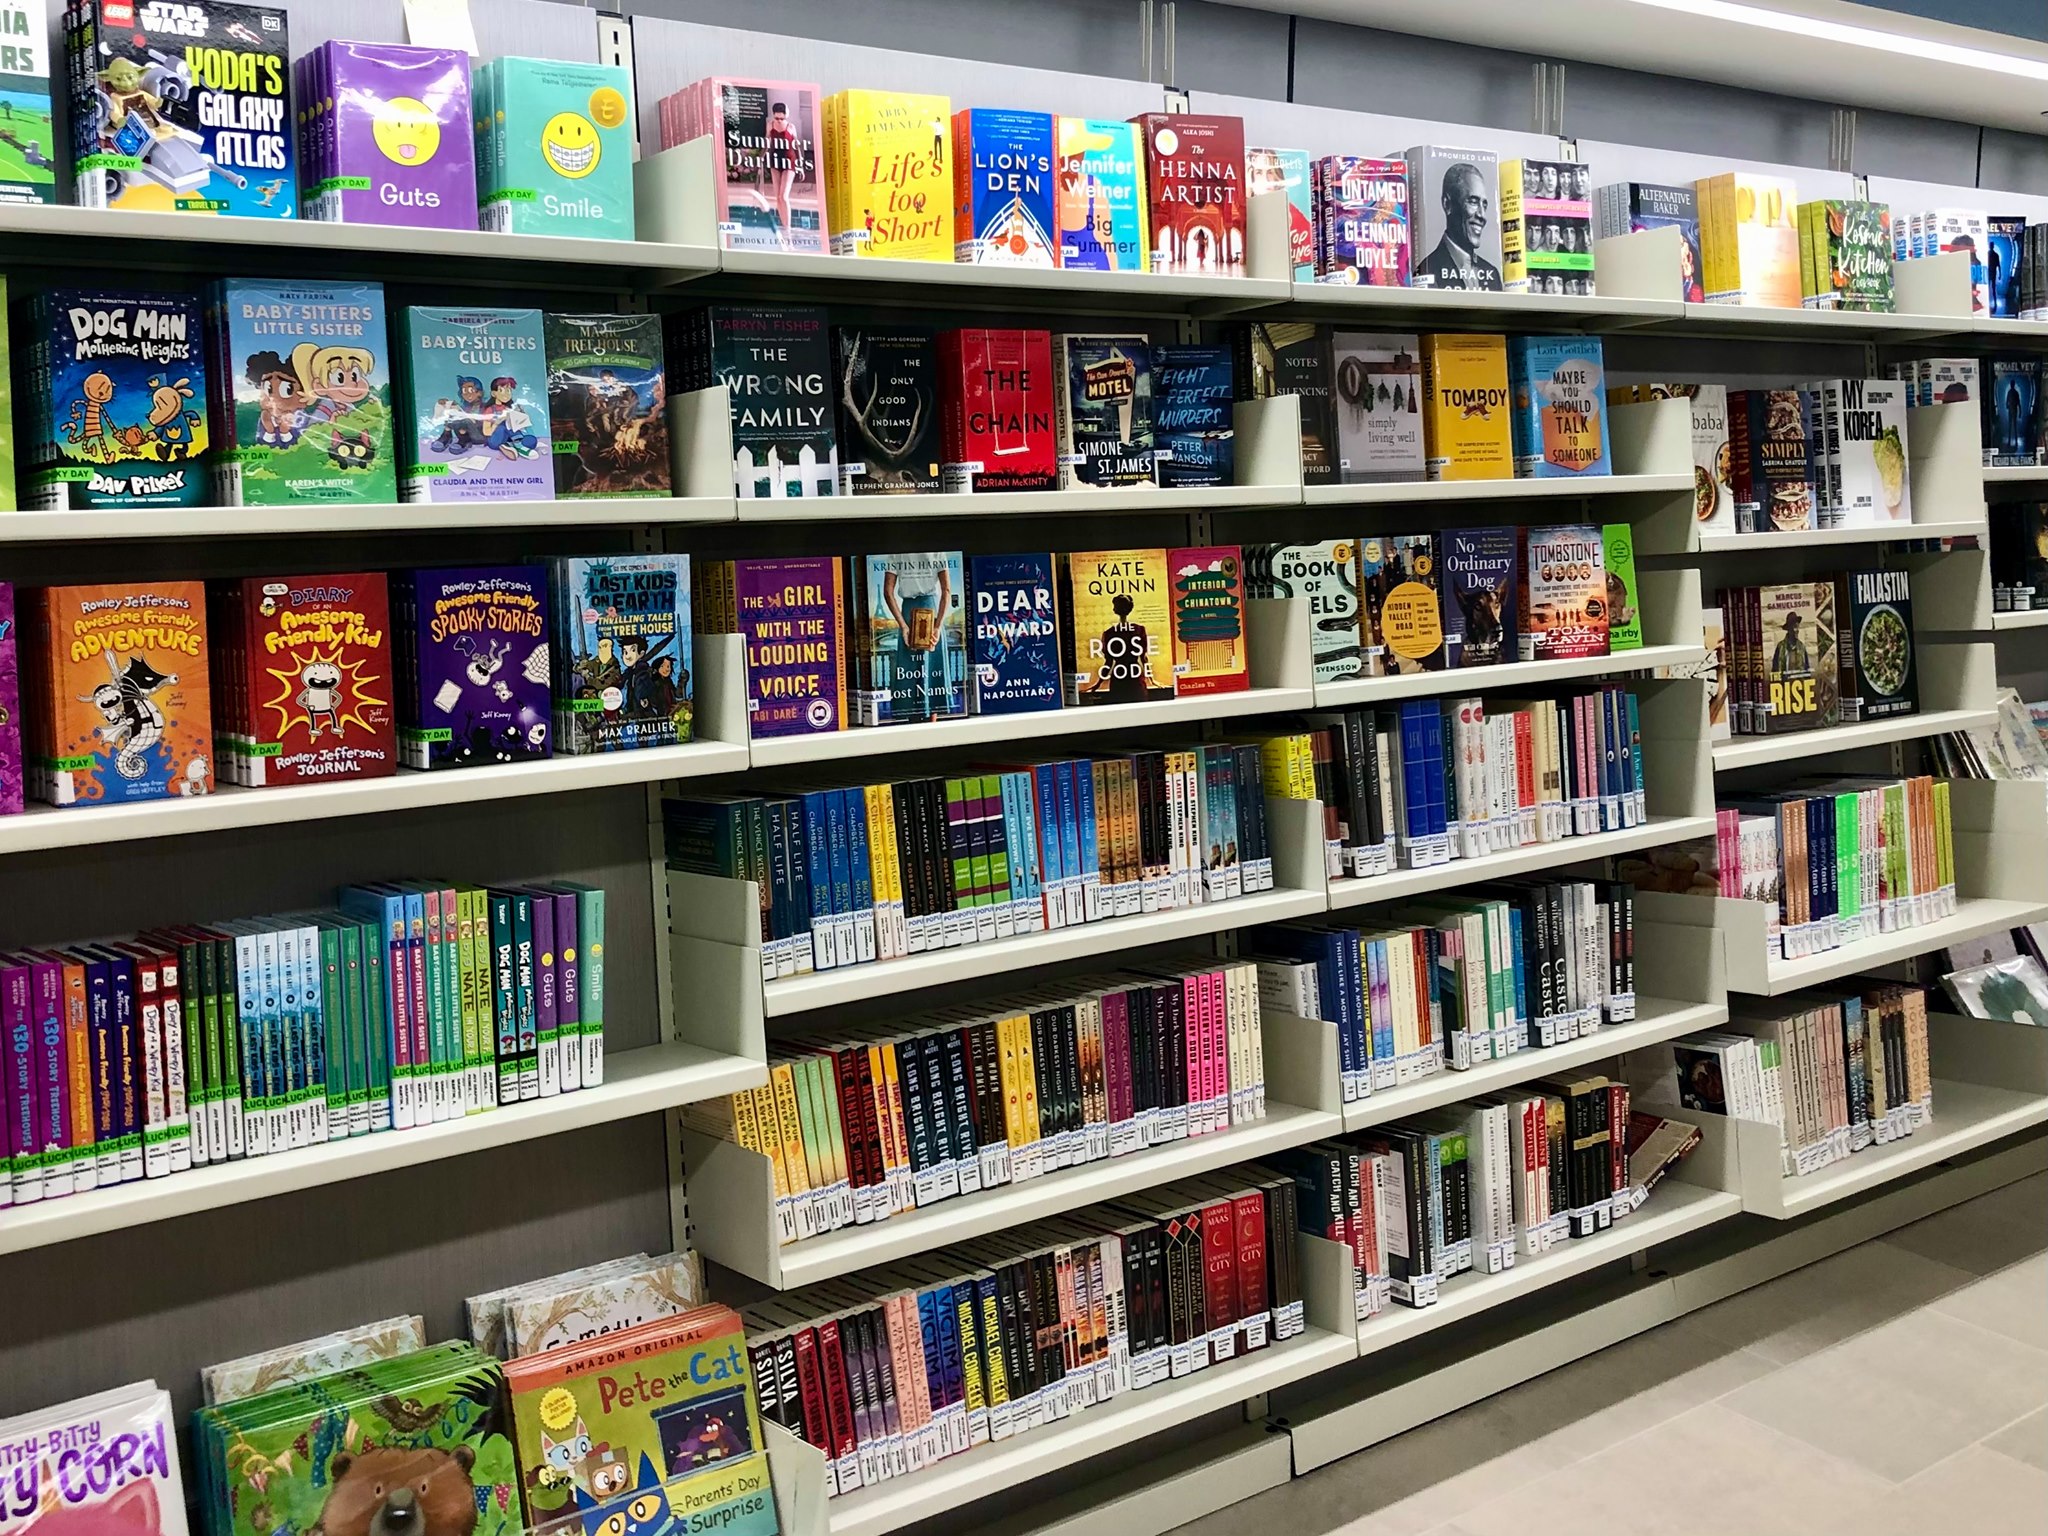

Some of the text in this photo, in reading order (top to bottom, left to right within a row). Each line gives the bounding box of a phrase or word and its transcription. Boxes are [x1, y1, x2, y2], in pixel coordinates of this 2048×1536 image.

[105, 4, 131, 18] LEGO
[140, 1, 205, 23] STAR
[139, 16, 209, 38] WARS
[263, 18, 279, 30] DK
[185, 46, 283, 96] YODA'S
[197, 92, 284, 133] GALAXY
[728, 129, 811, 151] Summer
[215, 131, 286, 170] ATLAS
[728, 150, 814, 174] Darlings
[868, 150, 942, 188] Life's
[976, 153, 1049, 172] LION'S
[1060, 154, 1134, 176] Jennifer
[1160, 160, 1237, 180] HENNA
[988, 174, 1040, 194] DEN
[1068, 179, 1131, 200] Weiner
[1342, 177, 1406, 206] UNTAMED
[380, 183, 440, 208] Guts
[888, 188, 926, 214] too
[1161, 186, 1236, 206] ARTIST
[1639, 188, 1691, 206] ALTERNATIVE
[544, 195, 604, 219] Smile
[1653, 201, 1679, 215] BAKER
[872, 214, 943, 246] Short
[1086, 216, 1113, 237] Big
[1344, 220, 1406, 245] GLENNON
[1067, 236, 1136, 254] Summer
[1356, 248, 1399, 270] DOYLE
[1441, 268, 1494, 281] BARACK
[242, 304, 372, 321] BABY-SITTERS
[68, 307, 128, 342] DOG
[134, 308, 187, 342] MAN
[253, 322, 363, 336] LITTLE SISTER
[422, 335, 536, 351] BABY-SITTERS
[459, 351, 502, 365] CLUB
[750, 348, 788, 362] THE
[1286, 357, 1318, 368] NOTES
[720, 374, 824, 396] WRONG
[984, 370, 1032, 392] THE
[1553, 371, 1586, 385] MAYBE
[1088, 380, 1132, 397] MOTEL
[1277, 386, 1328, 397] SILENCING
[1442, 388, 1508, 407] TOMBOY
[1562, 387, 1578, 398] YOU
[1842, 379, 1865, 411] MY
[1553, 401, 1591, 414] SHOULD
[969, 413, 1049, 434] CHAIN
[1368, 417, 1397, 431] simply
[1556, 416, 1589, 433] TALK
[1843, 411, 1884, 441] KOREA
[1368, 430, 1416, 445] living well
[1078, 441, 1123, 458] SIMONE
[1553, 449, 1598, 463] SOMEONE
[1761, 441, 1806, 460] SIMPLY
[1098, 458, 1152, 474] ST. JAMES
[1455, 538, 1475, 554] No
[1531, 542, 1600, 570] TOMBSTONE
[873, 560, 915, 572] KRISTIN
[1097, 562, 1145, 578] KATE
[1281, 561, 1335, 579] BOOK
[1447, 555, 1512, 574] Ordinary
[1088, 578, 1155, 596] QUINN
[1304, 580, 1322, 592] OF
[1466, 572, 1496, 592] Dog
[1856, 570, 1910, 604] FALASTIN
[81, 594, 189, 614] Rowley Jefferson's
[290, 587, 354, 605] DIARY
[743, 585, 826, 608] THE GIRL
[977, 588, 1052, 613] DEAR
[74, 610, 199, 636] Awesome Friendly
[279, 611, 366, 630] Awesome
[431, 606, 543, 643] SPOOKY STORIES
[756, 620, 825, 638] WITH THE
[977, 620, 1054, 640] EDWARD
[264, 626, 382, 654] Friendly Kid
[1535, 632, 1605, 646] CLAVIN
[1548, 626, 1590, 637] TOM
[70, 629, 203, 662] ADVENTURE
[749, 642, 828, 667] LOUDING
[1089, 636, 1160, 659] ROSE
[1098, 662, 1154, 681] CODE
[760, 674, 820, 699] VOICE
[984, 686, 1055, 700] NAPOLITANO
[1770, 679, 1817, 716] RISE
[754, 709, 769, 721] ABI
[599, 721, 675, 739] MAX BRALLIER
[297, 759, 361, 776] JOURNAL
[43, 1017, 61, 1140] 130-STORY TREEHOUSE
[905, 1063, 926, 1137] LONG BRIGHT
[1535, 1116, 1546, 1164] SAPIENS
[1348, 1155, 1362, 1231] CATCH AND KILL
[1210, 1326, 1235, 1338] POPULAR
[565, 1330, 704, 1375] AMAZON ORIGINAL
[958, 1301, 984, 1412] MICHAEL CONNELLY
[599, 1344, 747, 1415] Pete the Cat
[756, 1357, 777, 1412] SILVA
[57, 1420, 169, 1503] CORN
[685, 1474, 761, 1510] Parents' Day
[690, 1496, 765, 1534] Surprise
